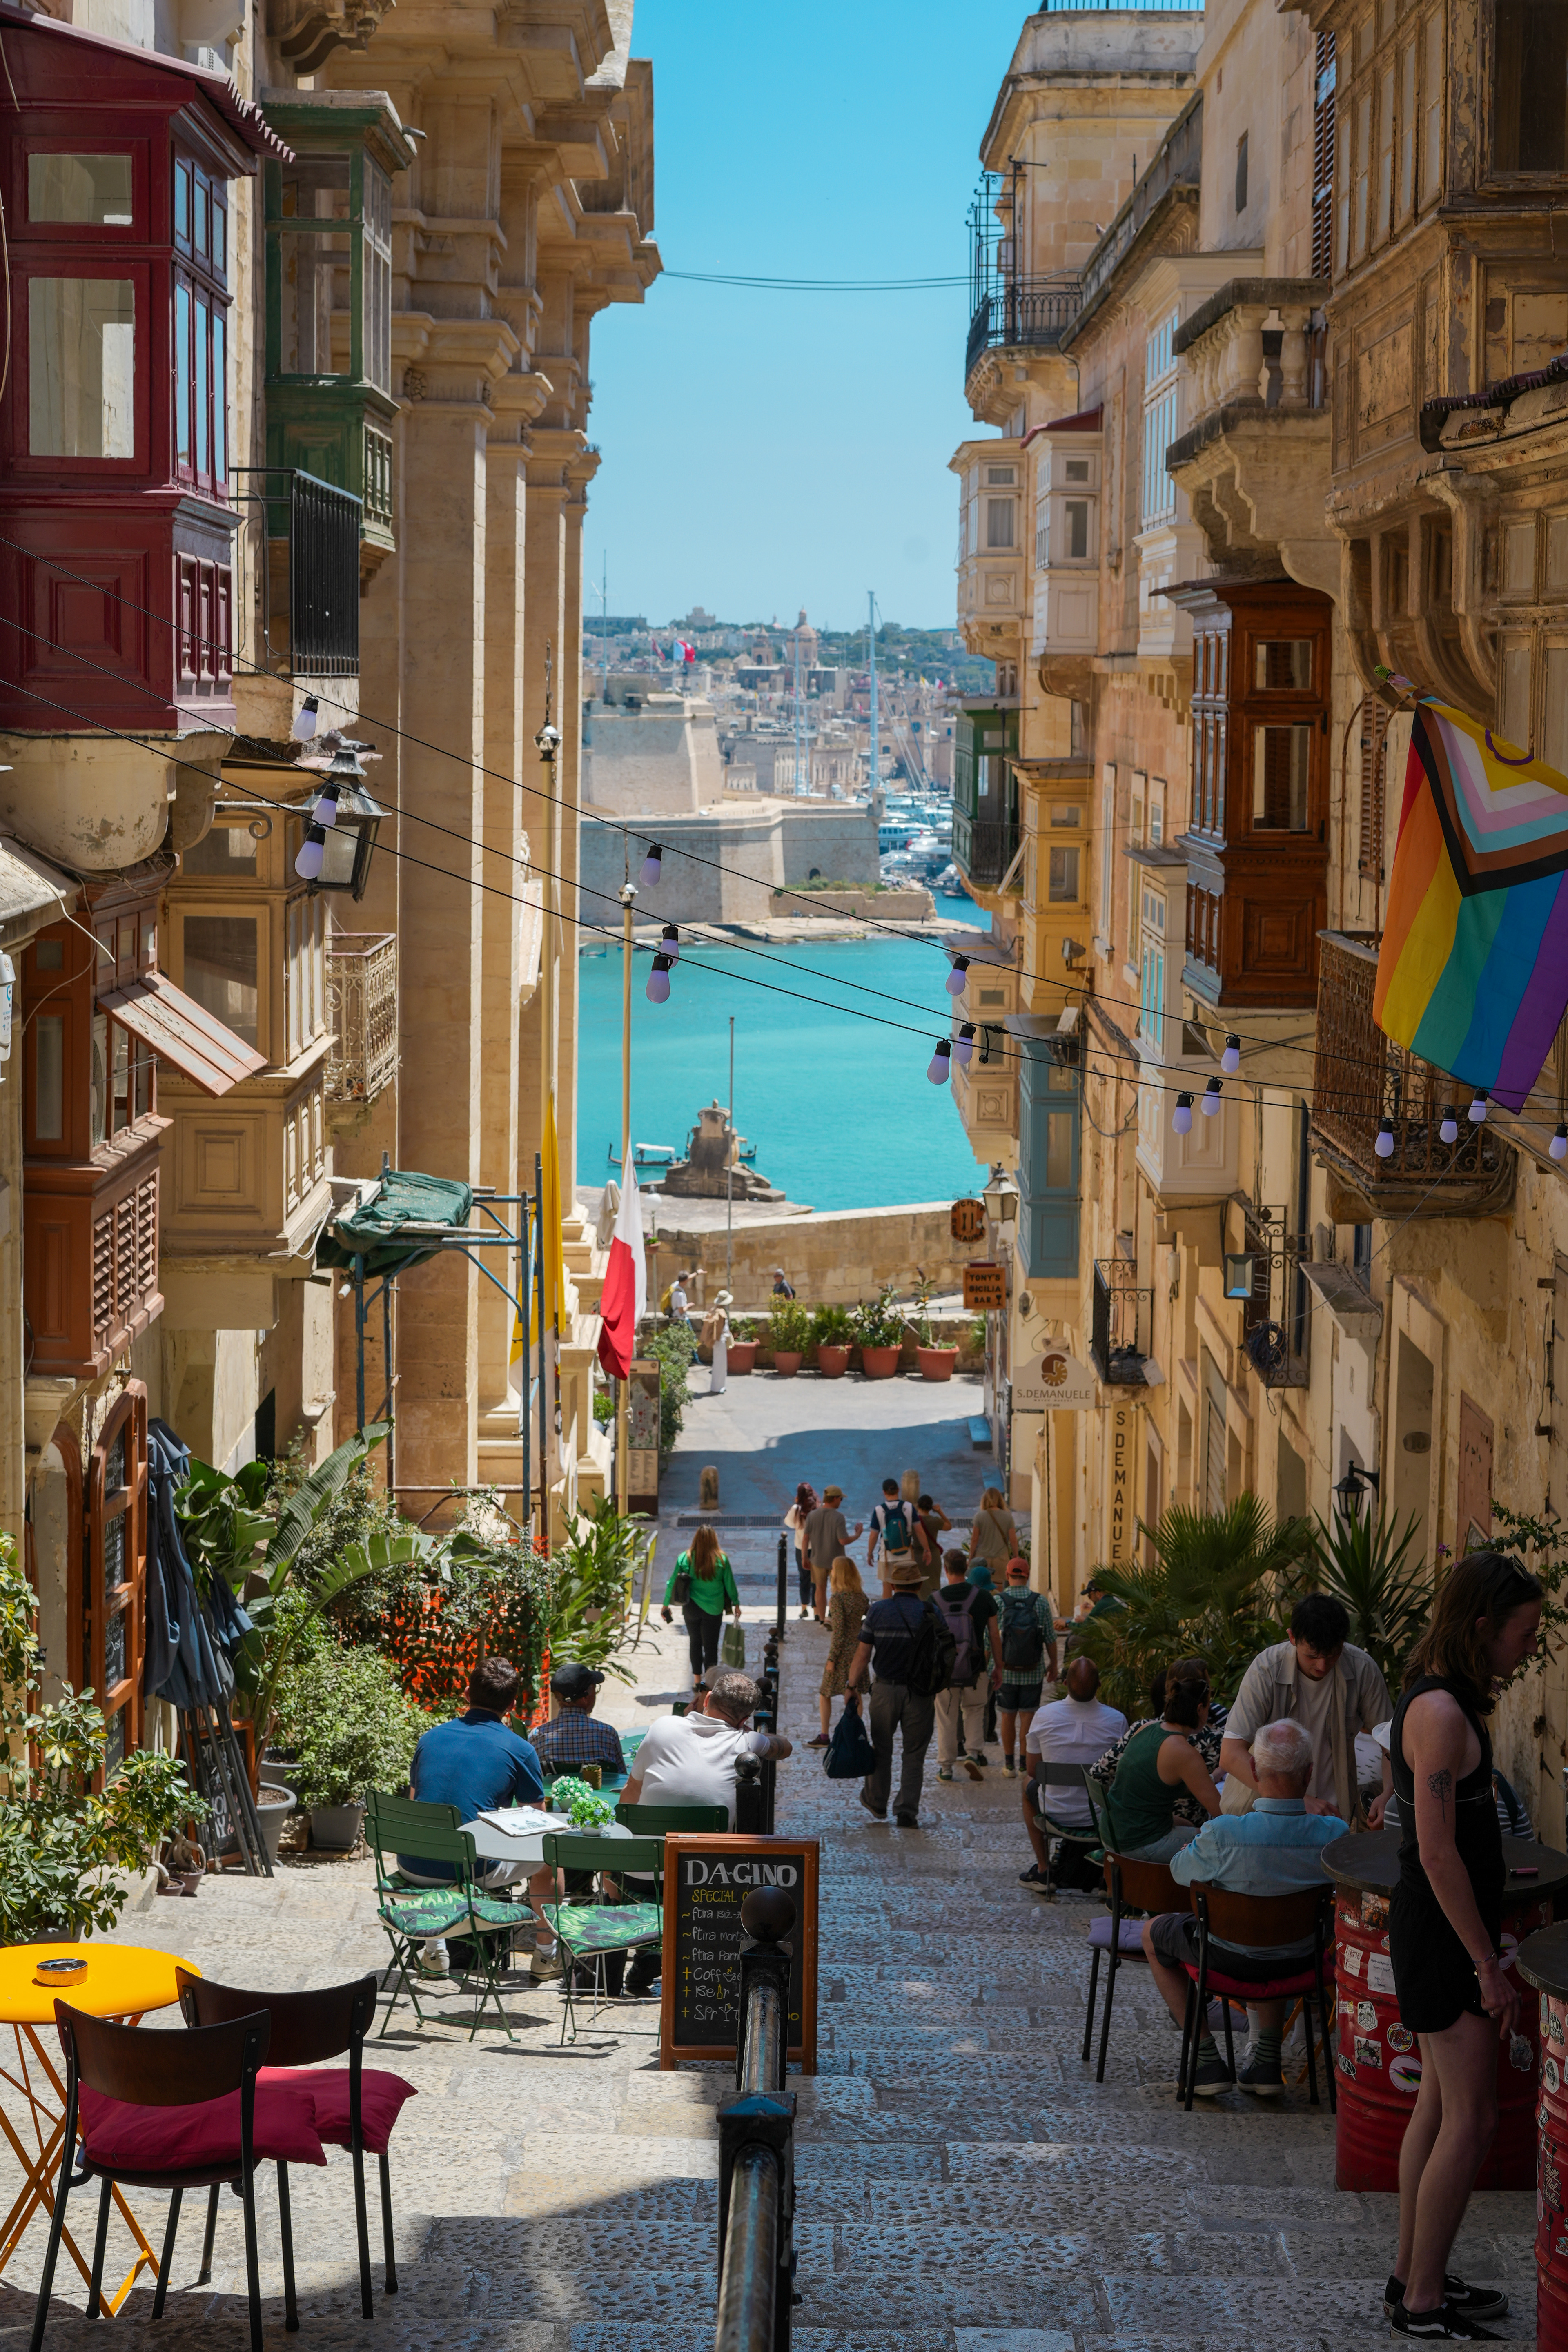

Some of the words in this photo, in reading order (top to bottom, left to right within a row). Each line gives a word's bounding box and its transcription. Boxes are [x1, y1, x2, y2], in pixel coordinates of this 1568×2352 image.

[952, 1200, 984, 1212] SICILIA
[1017, 1389, 1091, 1399] S.DEMANUELE
[1112, 1433, 1126, 1570] DEMANUE
[691, 1889, 738, 1903] SPECIAL
[692, 1907, 713, 1921] ftira
[692, 1926, 717, 1943] ftira
[692, 1947, 714, 1962] ftira
[1349, 1948, 1362, 1960] serve
